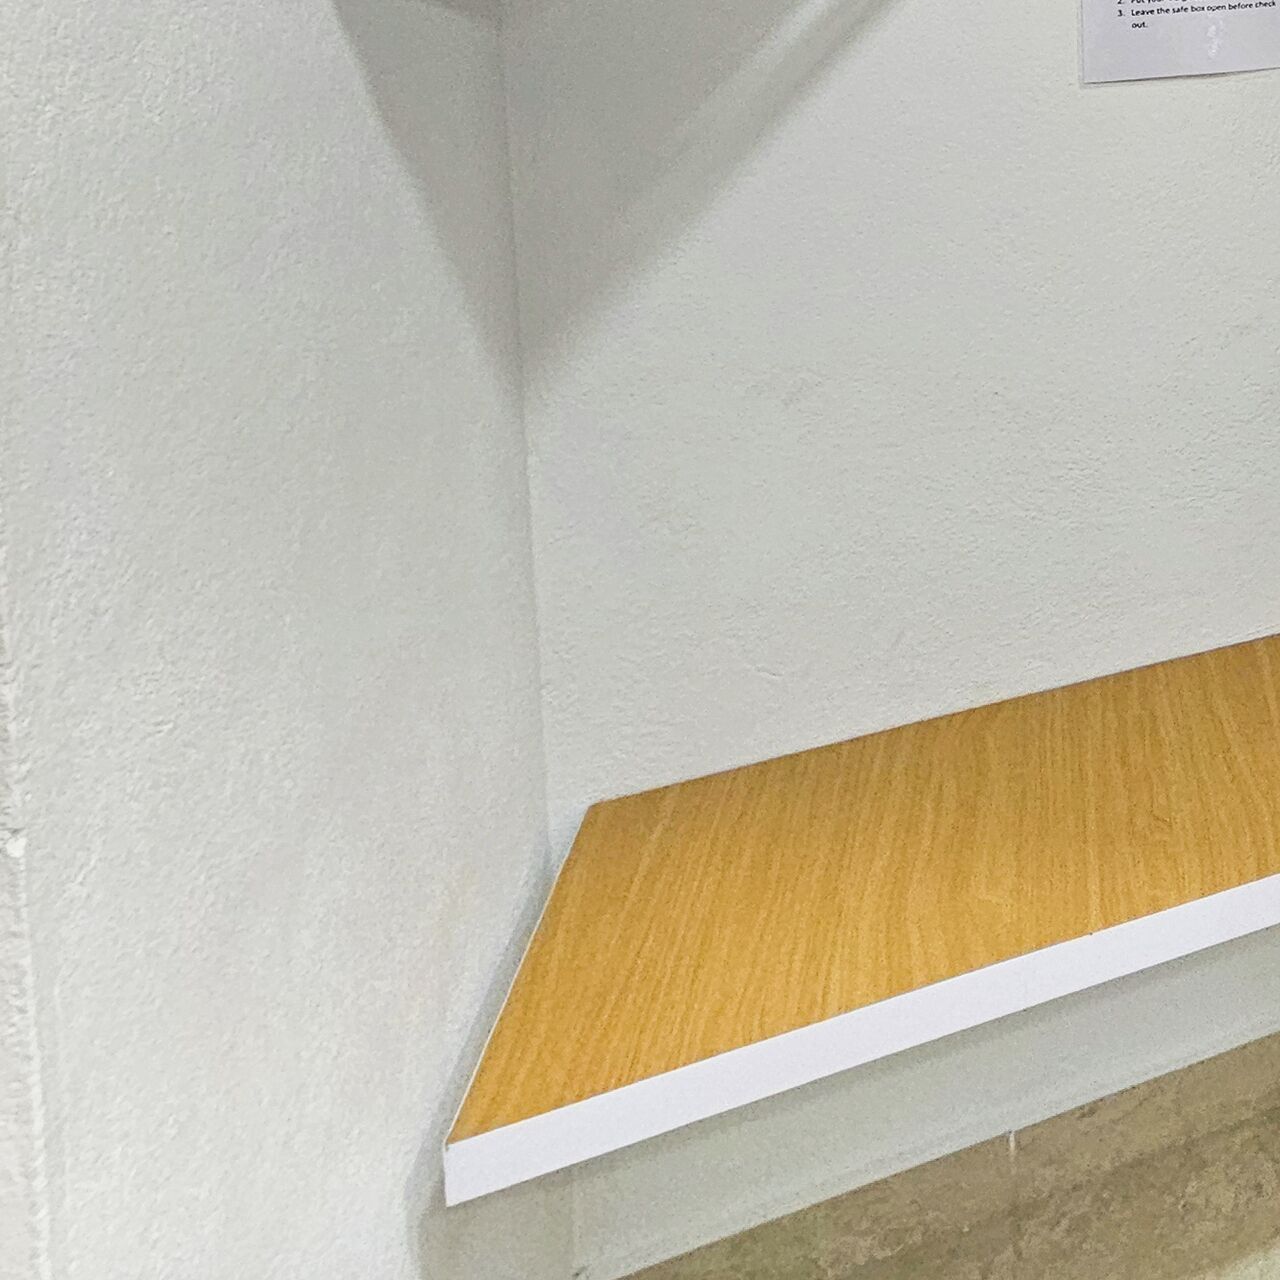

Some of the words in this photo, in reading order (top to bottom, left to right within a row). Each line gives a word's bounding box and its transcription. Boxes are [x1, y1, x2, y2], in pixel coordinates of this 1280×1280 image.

[1131, 8, 1155, 17] Leave
[1157, 7, 1170, 15] the
[1207, 4, 1226, 12] open
[1228, 2, 1253, 10] before
[1255, 0, 1276, 8] check
